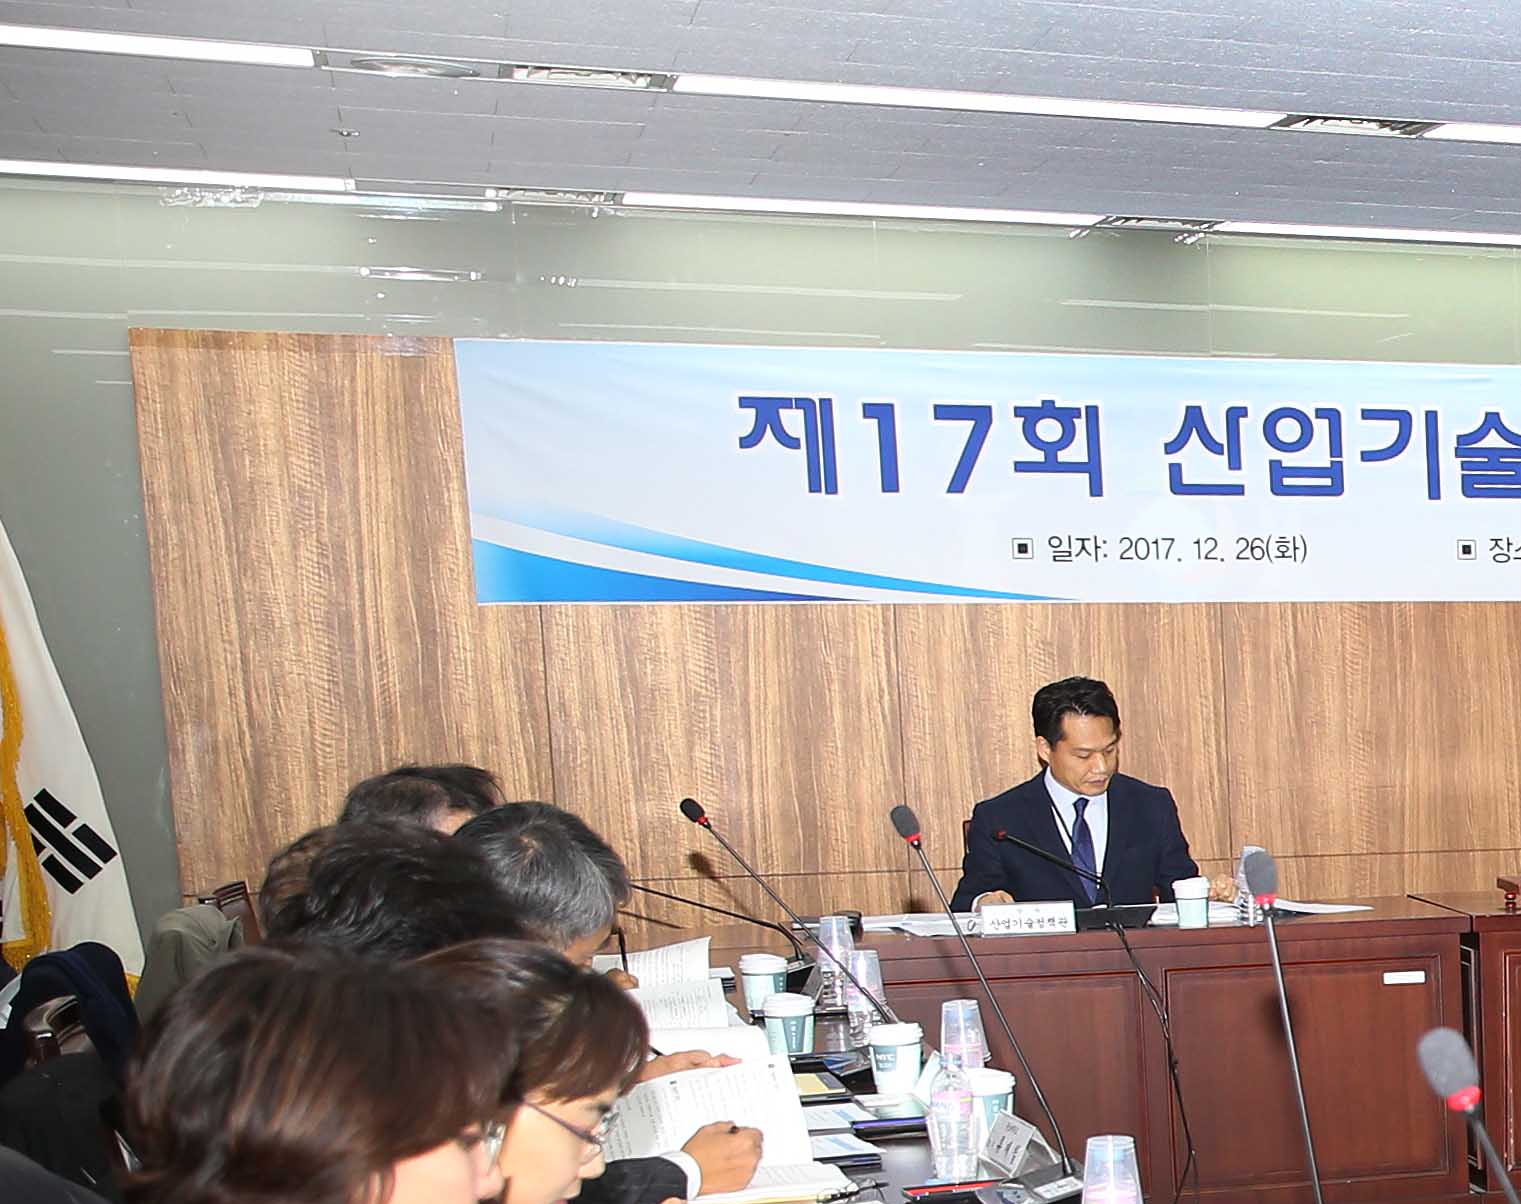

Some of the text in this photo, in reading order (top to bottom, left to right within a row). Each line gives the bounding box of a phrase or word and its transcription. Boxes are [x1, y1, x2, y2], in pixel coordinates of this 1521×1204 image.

[737, 395, 1104, 499] 제17회
[1046, 534, 1109, 564] 일자:
[1235, 534, 1308, 564] 26(화)
